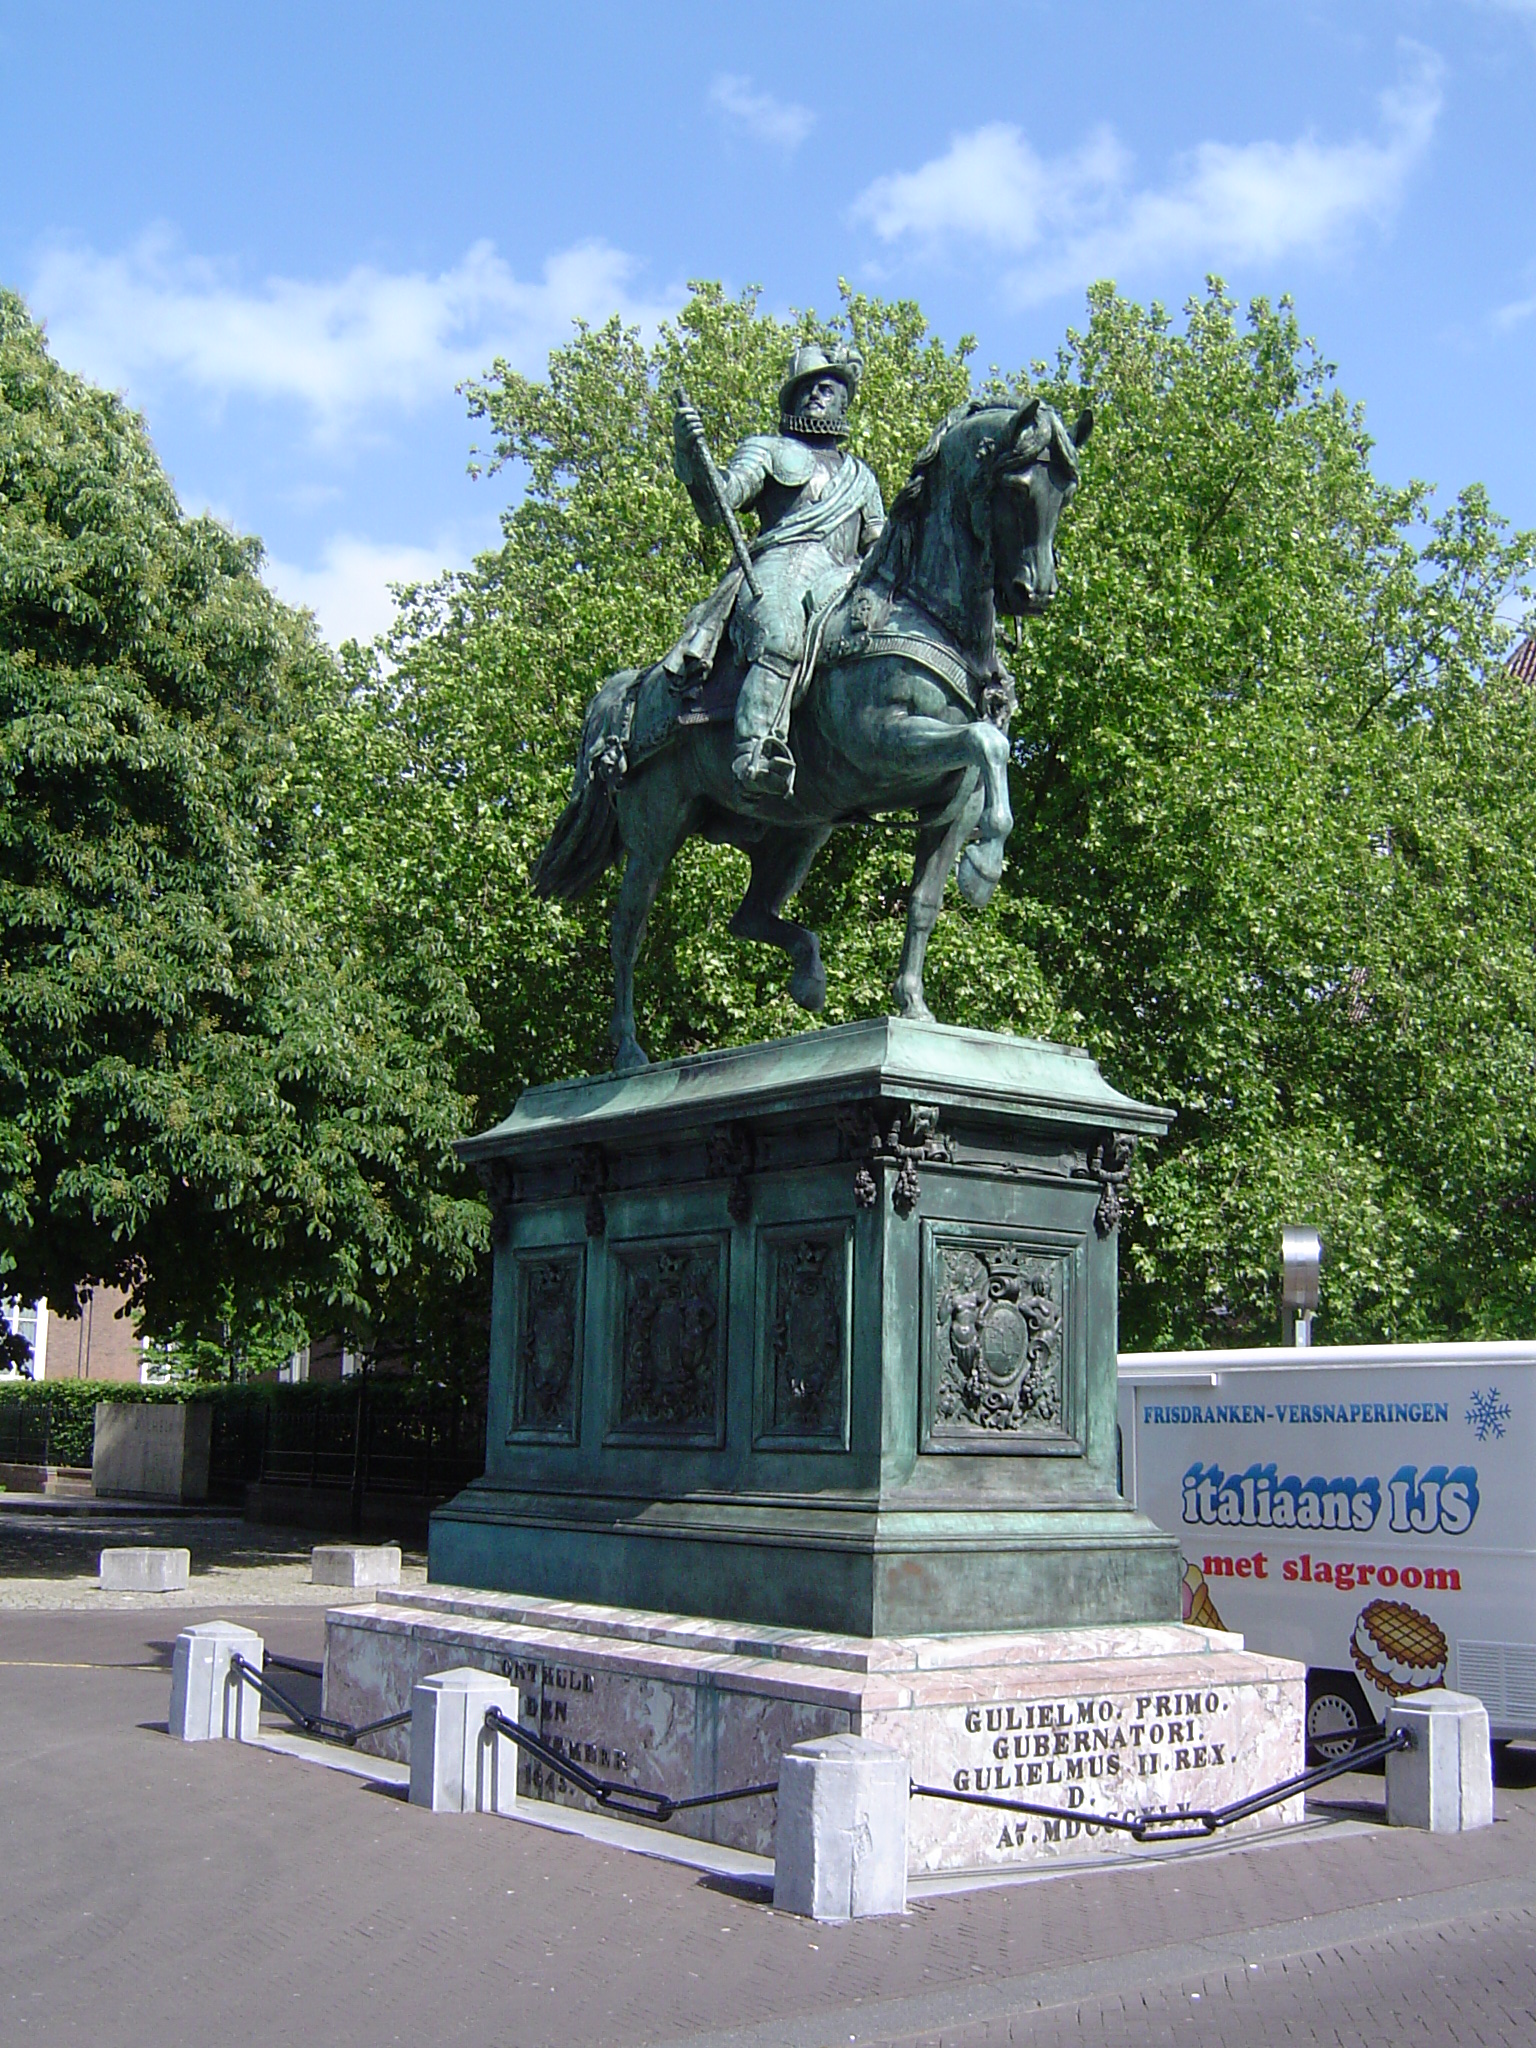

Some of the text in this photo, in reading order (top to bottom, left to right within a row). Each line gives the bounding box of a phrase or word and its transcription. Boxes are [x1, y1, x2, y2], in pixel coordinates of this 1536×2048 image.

[1144, 1402, 1449, 1424] FRISDRANKEN-VERSNAPERINGEN
[1182, 1462, 1480, 1534] italiaans IJS
[1203, 1552, 1462, 1591] met slagroom
[965, 1692, 1228, 1733] GULIELMO. PRIMO.
[993, 1719, 1205, 1760] GUBERNATORI.
[953, 1755, 1120, 1792] GULIELMUS
